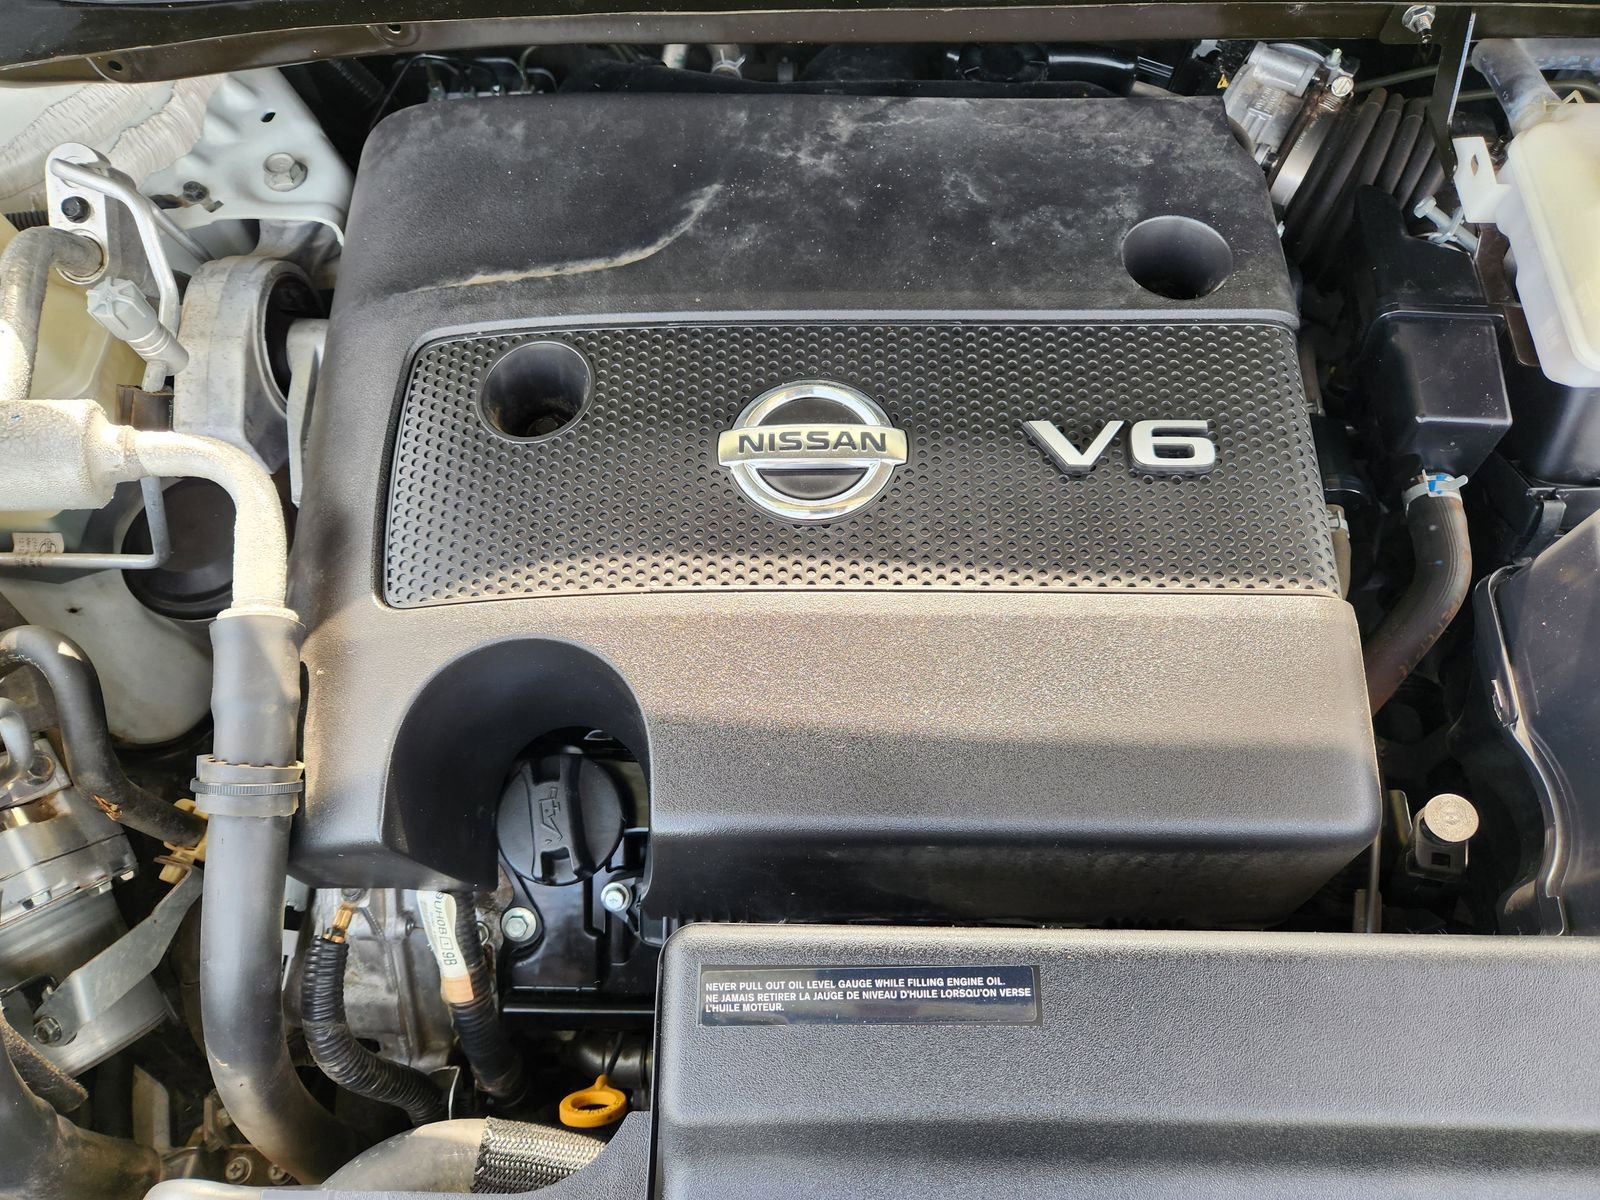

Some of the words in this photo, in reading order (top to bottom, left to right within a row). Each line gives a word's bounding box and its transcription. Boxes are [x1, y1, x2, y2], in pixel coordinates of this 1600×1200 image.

[738, 431, 887, 453] NISSAN
[1022, 419, 1216, 475] V6
[705, 982, 737, 991] NEVER
[740, 982, 763, 991] PULL
[765, 981, 786, 990] OUT
[788, 981, 804, 989] OIL
[807, 980, 836, 989] LEVEL
[838, 979, 872, 988] GAUGE
[875, 979, 905, 988] WHILE
[907, 978, 944, 987] FILLING
[947, 977, 984, 986] ENGINE
[986, 977, 1006, 986] OIL.
[705, 994, 719, 1003] NE
[720, 993, 755, 1003] JAMAIS
[757, 993, 796, 1002] RETIRER
[799, 992, 810, 1001] LA
[813, 991, 844, 1000] JAUGE
[846, 991, 860, 1000] DE
[862, 990, 898, 1000] NIVEAU
[900, 989, 938, 999] D'HUILE
[940, 988, 997, 998] LORSQU'ON
[999, 988, 1032, 997] VERSE
[705, 1003, 740, 1012] L'HUILE
[742, 1002, 784, 1012] MOTEUR.
